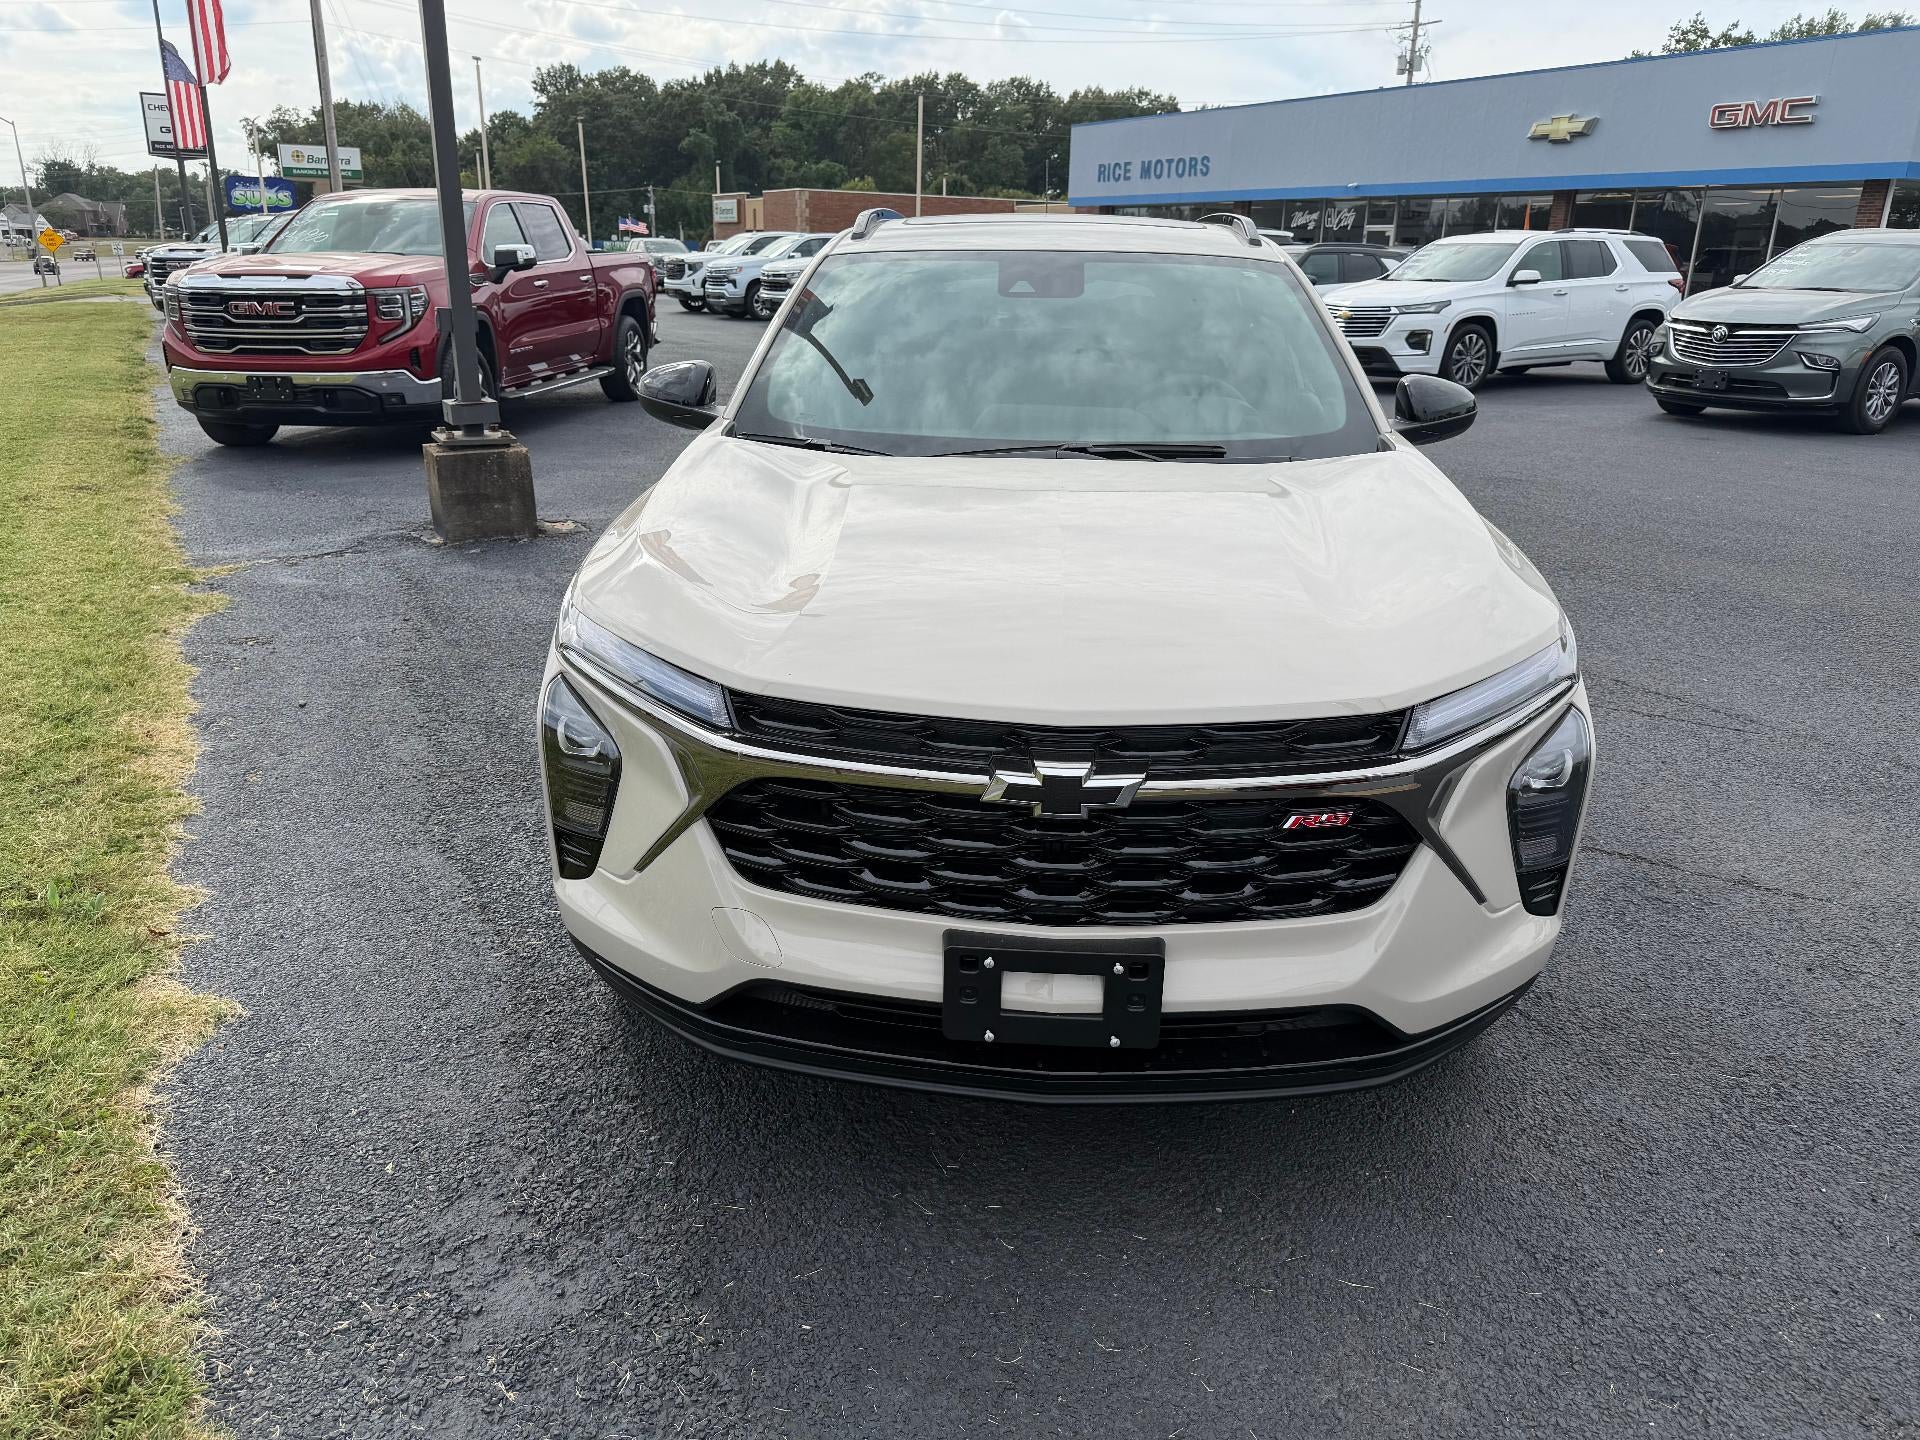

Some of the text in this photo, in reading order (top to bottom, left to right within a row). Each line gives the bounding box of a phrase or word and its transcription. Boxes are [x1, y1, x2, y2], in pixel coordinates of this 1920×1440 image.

[1708, 95, 1820, 128] GMC
[1097, 155, 1211, 183] RICE MOTORS
[228, 301, 296, 316] GMC
[1282, 811, 1354, 829] RS
